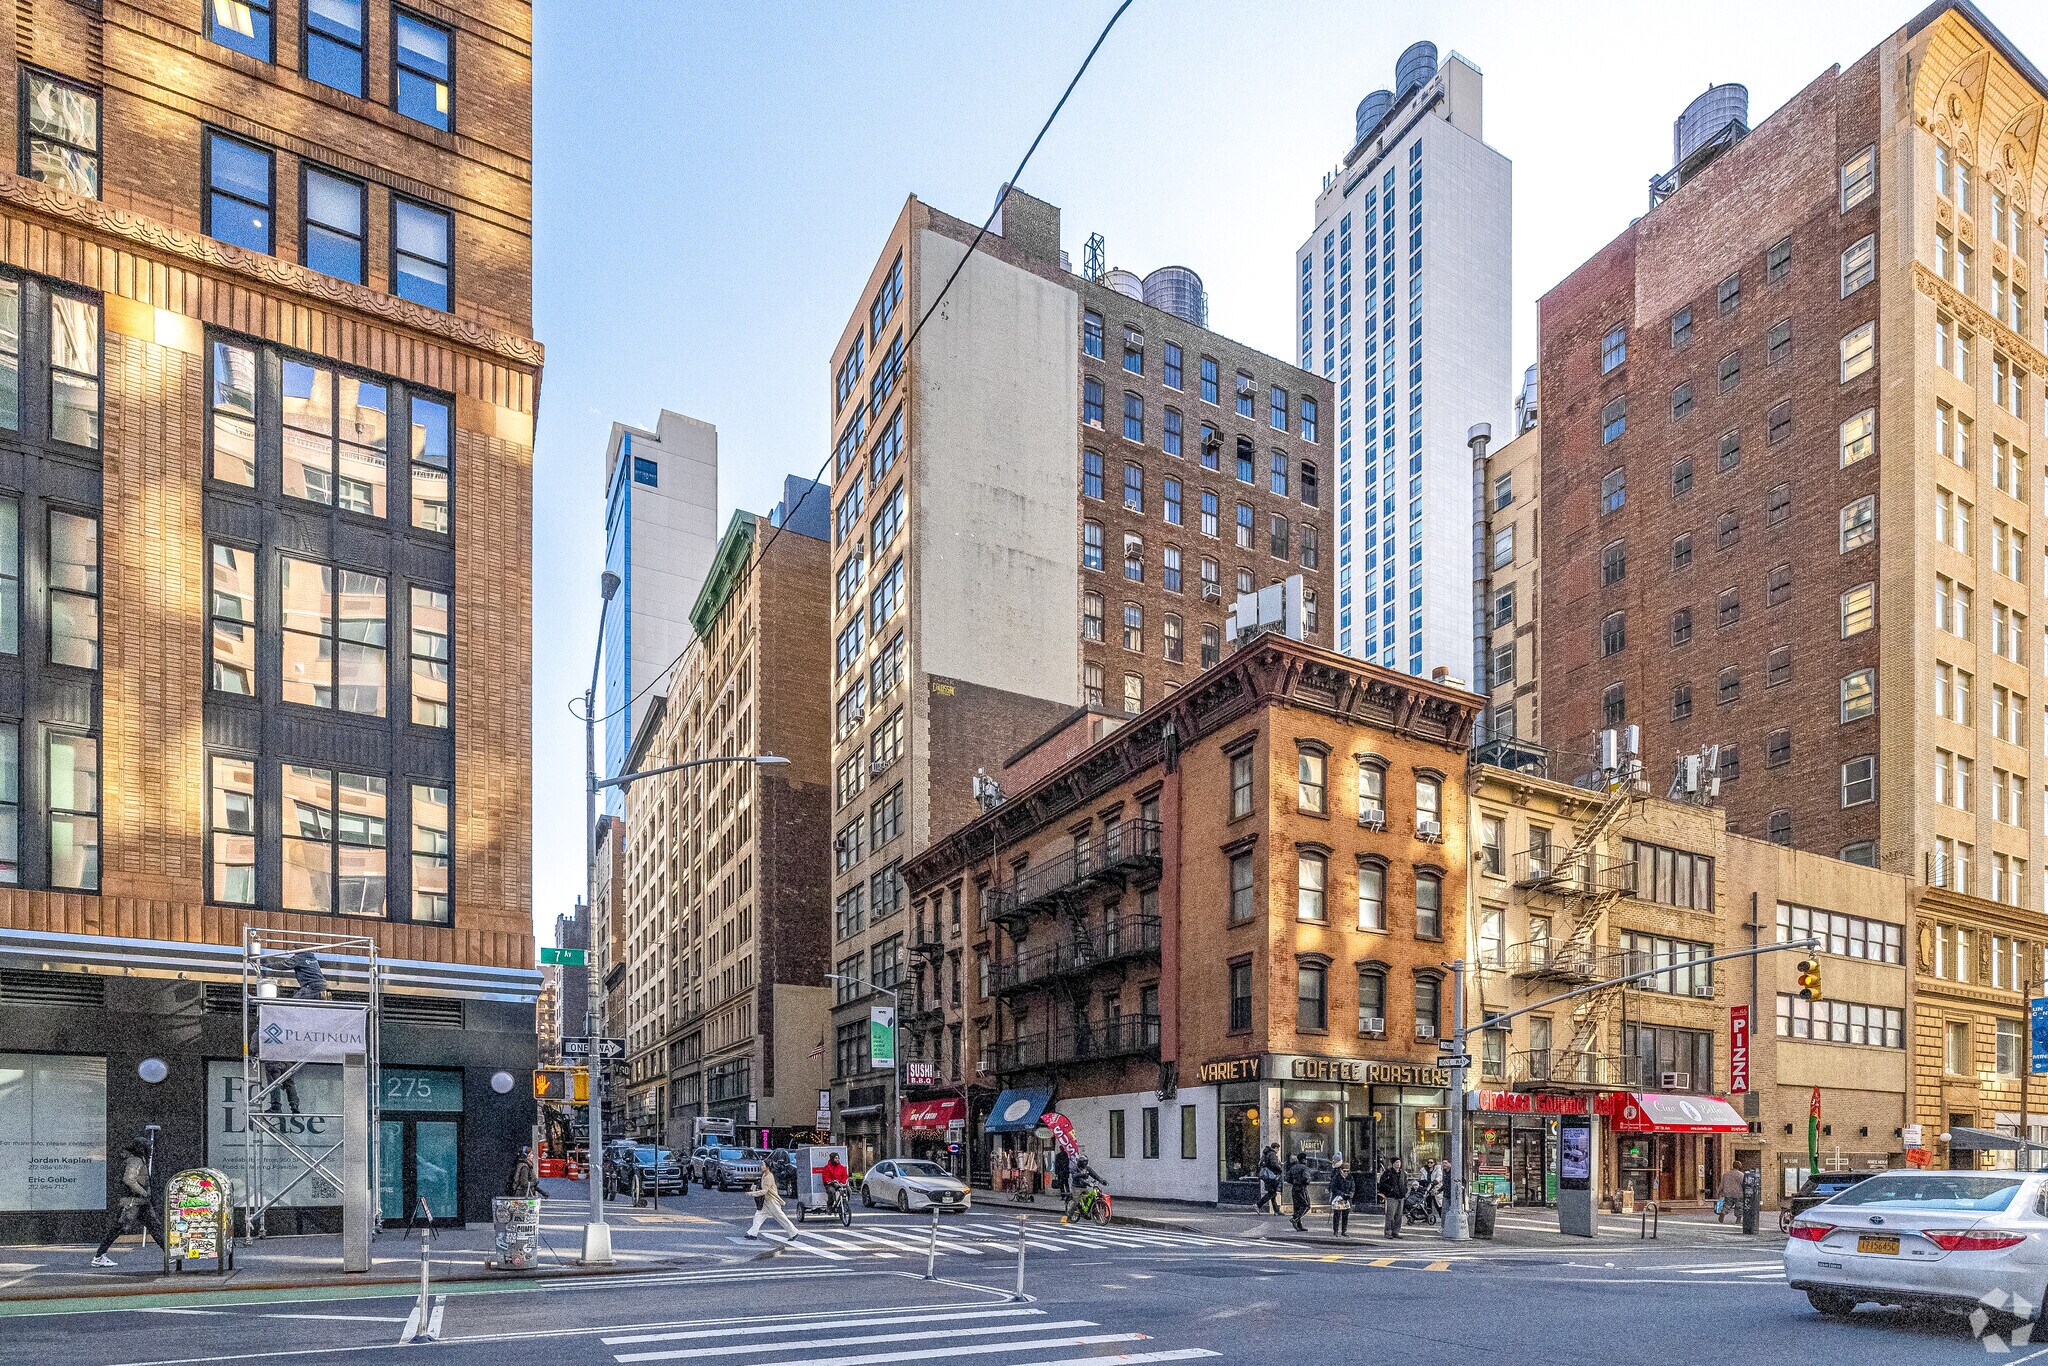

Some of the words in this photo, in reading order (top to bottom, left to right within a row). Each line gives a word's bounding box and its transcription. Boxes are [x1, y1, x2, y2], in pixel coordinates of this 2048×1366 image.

[555, 951, 560, 962] 7
[285, 1029, 362, 1044] PLATINUM
[570, 1043, 588, 1052] ONE
[1732, 1018, 1746, 1090] PIZZA
[910, 1063, 933, 1078] SUSHI
[1200, 1059, 1259, 1081] VARIETY
[1295, 1060, 1362, 1080] COFFEE
[1369, 1064, 1451, 1086] ROASTERS
[388, 1077, 431, 1097] 275
[1479, 1089, 1531, 1112] Chelsea
[1300, 1140, 1325, 1151] VARIETY
[62, 1157, 92, 1165] Kaplan
